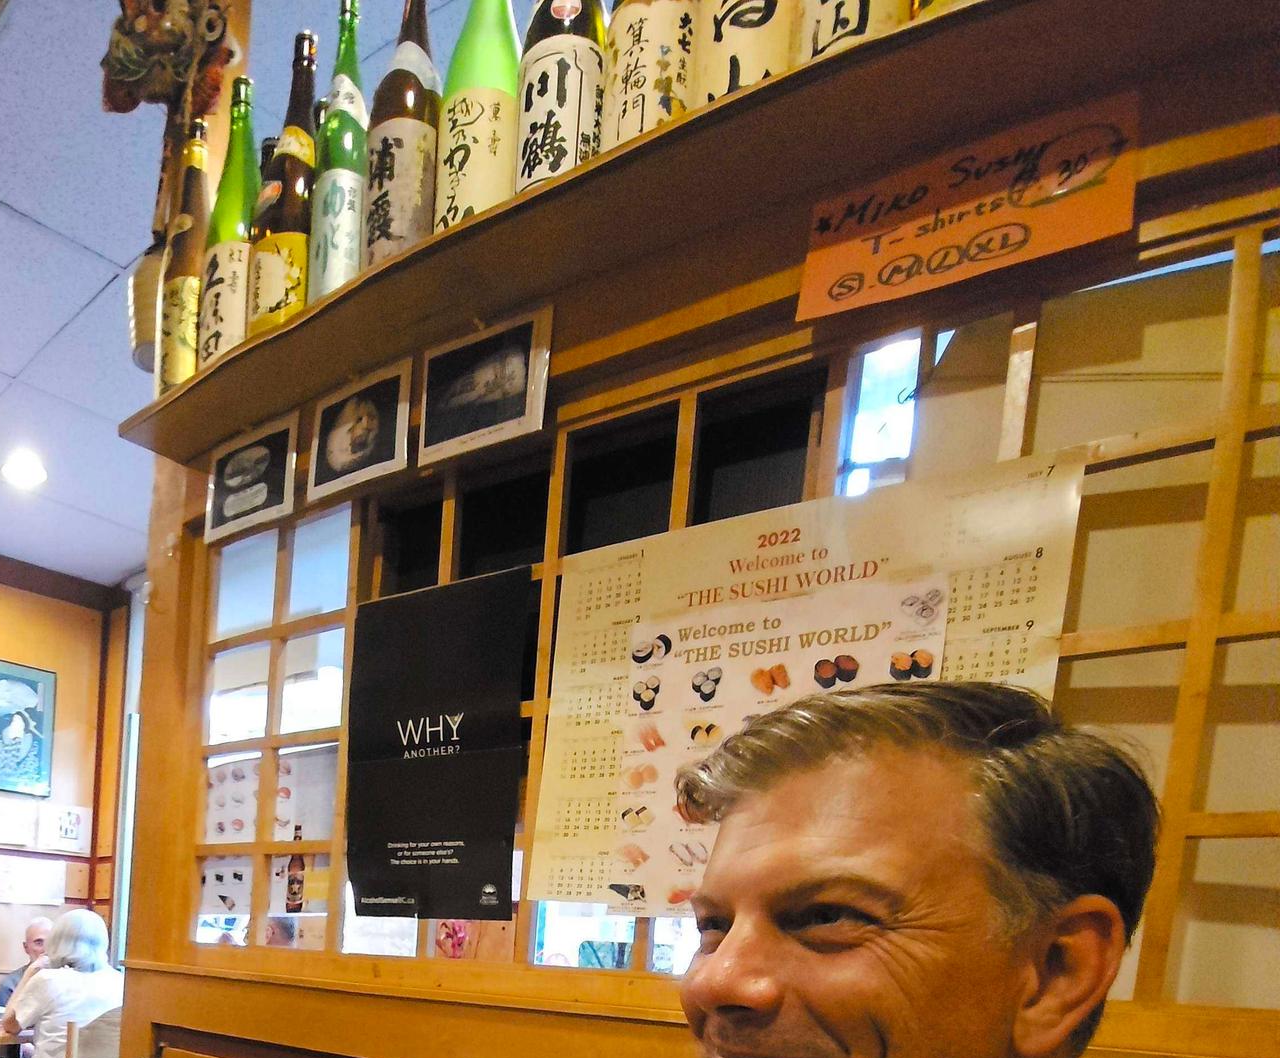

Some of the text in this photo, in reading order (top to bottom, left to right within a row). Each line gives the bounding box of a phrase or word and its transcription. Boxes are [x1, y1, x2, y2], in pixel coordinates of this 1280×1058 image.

[520, 57, 571, 178] 川鶴
[367, 136, 405, 247] 浦霞
[1045, 465, 1055, 477] 7
[757, 527, 801, 549] 2022
[729, 547, 829, 575] Welcome to
[1035, 547, 1044, 559] 8
[728, 576, 790, 601] SUSHI
[636, 615, 641, 624] 2
[678, 616, 782, 643] Welcome to
[982, 619, 1034, 634] SEPTEMBER 9
[728, 636, 790, 659] SUSHI
[397, 711, 463, 746] WHY
[403, 745, 461, 760] ANOTHER?
